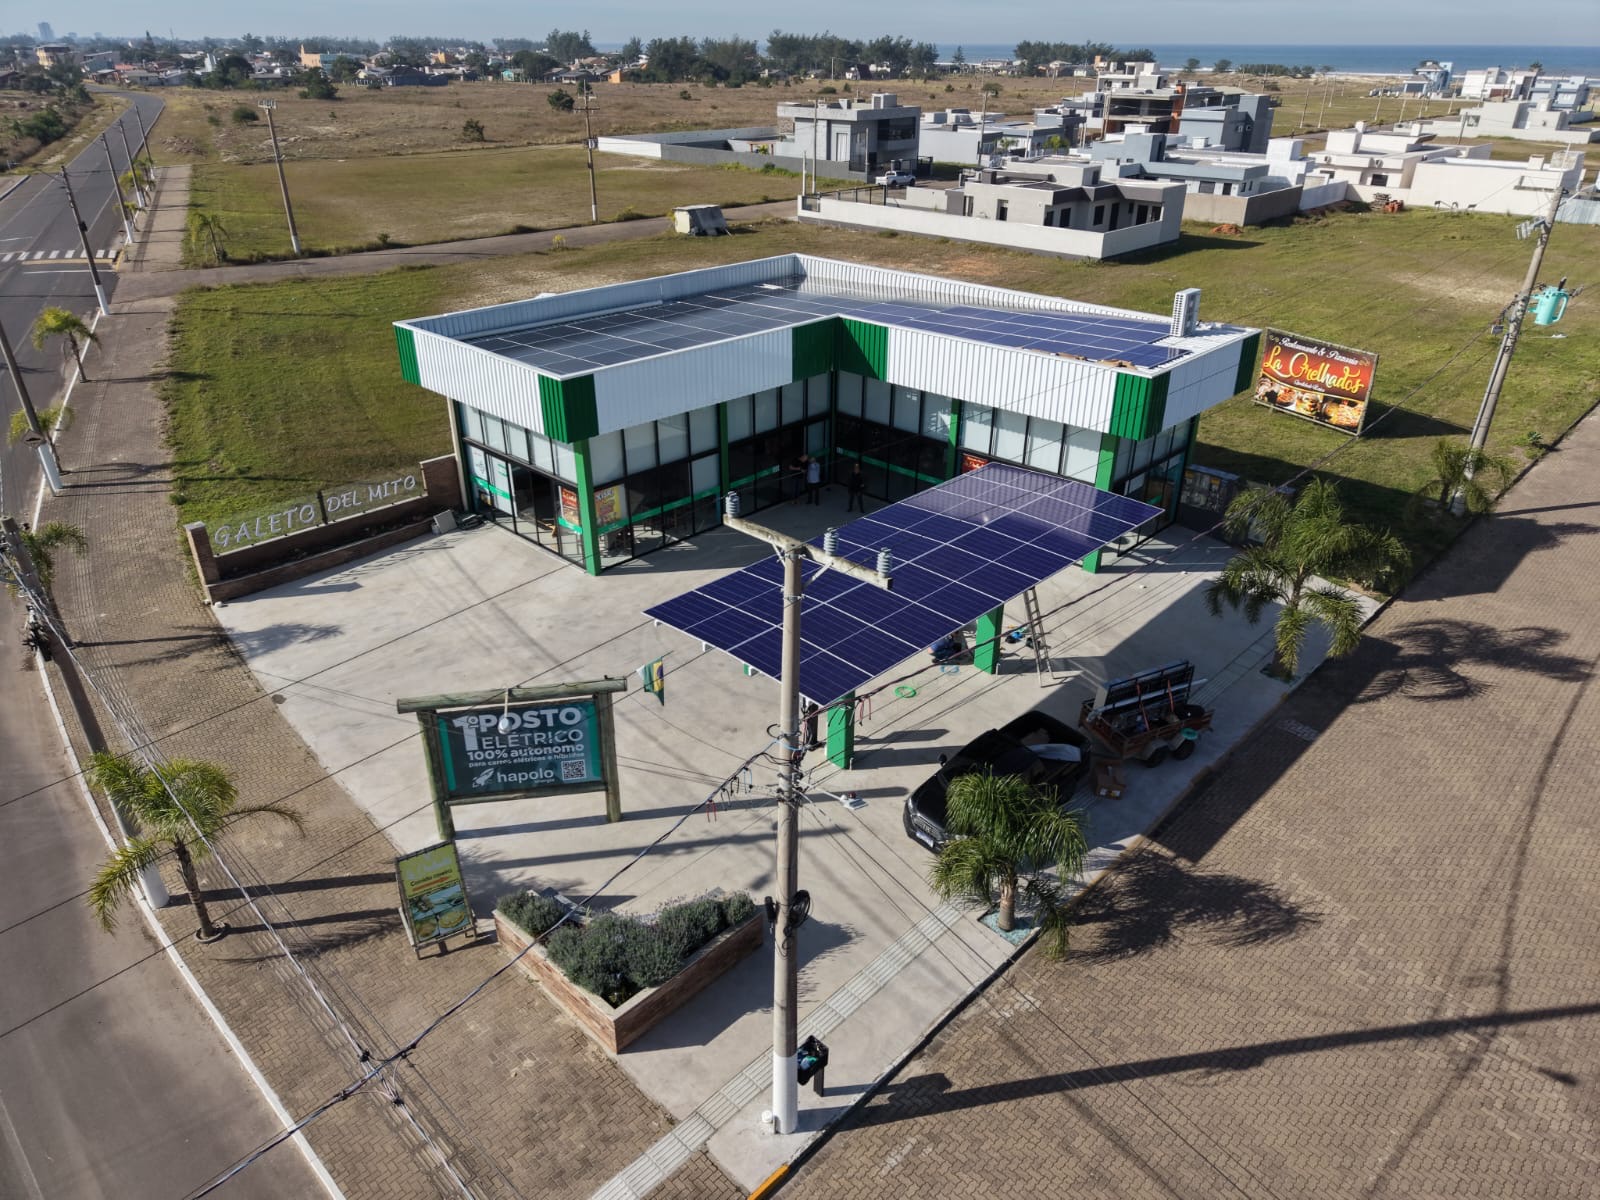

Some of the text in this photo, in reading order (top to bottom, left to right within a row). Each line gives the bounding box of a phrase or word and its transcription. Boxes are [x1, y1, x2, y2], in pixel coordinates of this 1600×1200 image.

[1264, 346, 1290, 377] La
[214, 475, 416, 547] GALETO DEL MITO
[479, 707, 582, 733] POSTO
[482, 729, 584, 750] ELÉTRICO
[467, 748, 508, 761] 100%
[497, 768, 555, 784] hapolo
